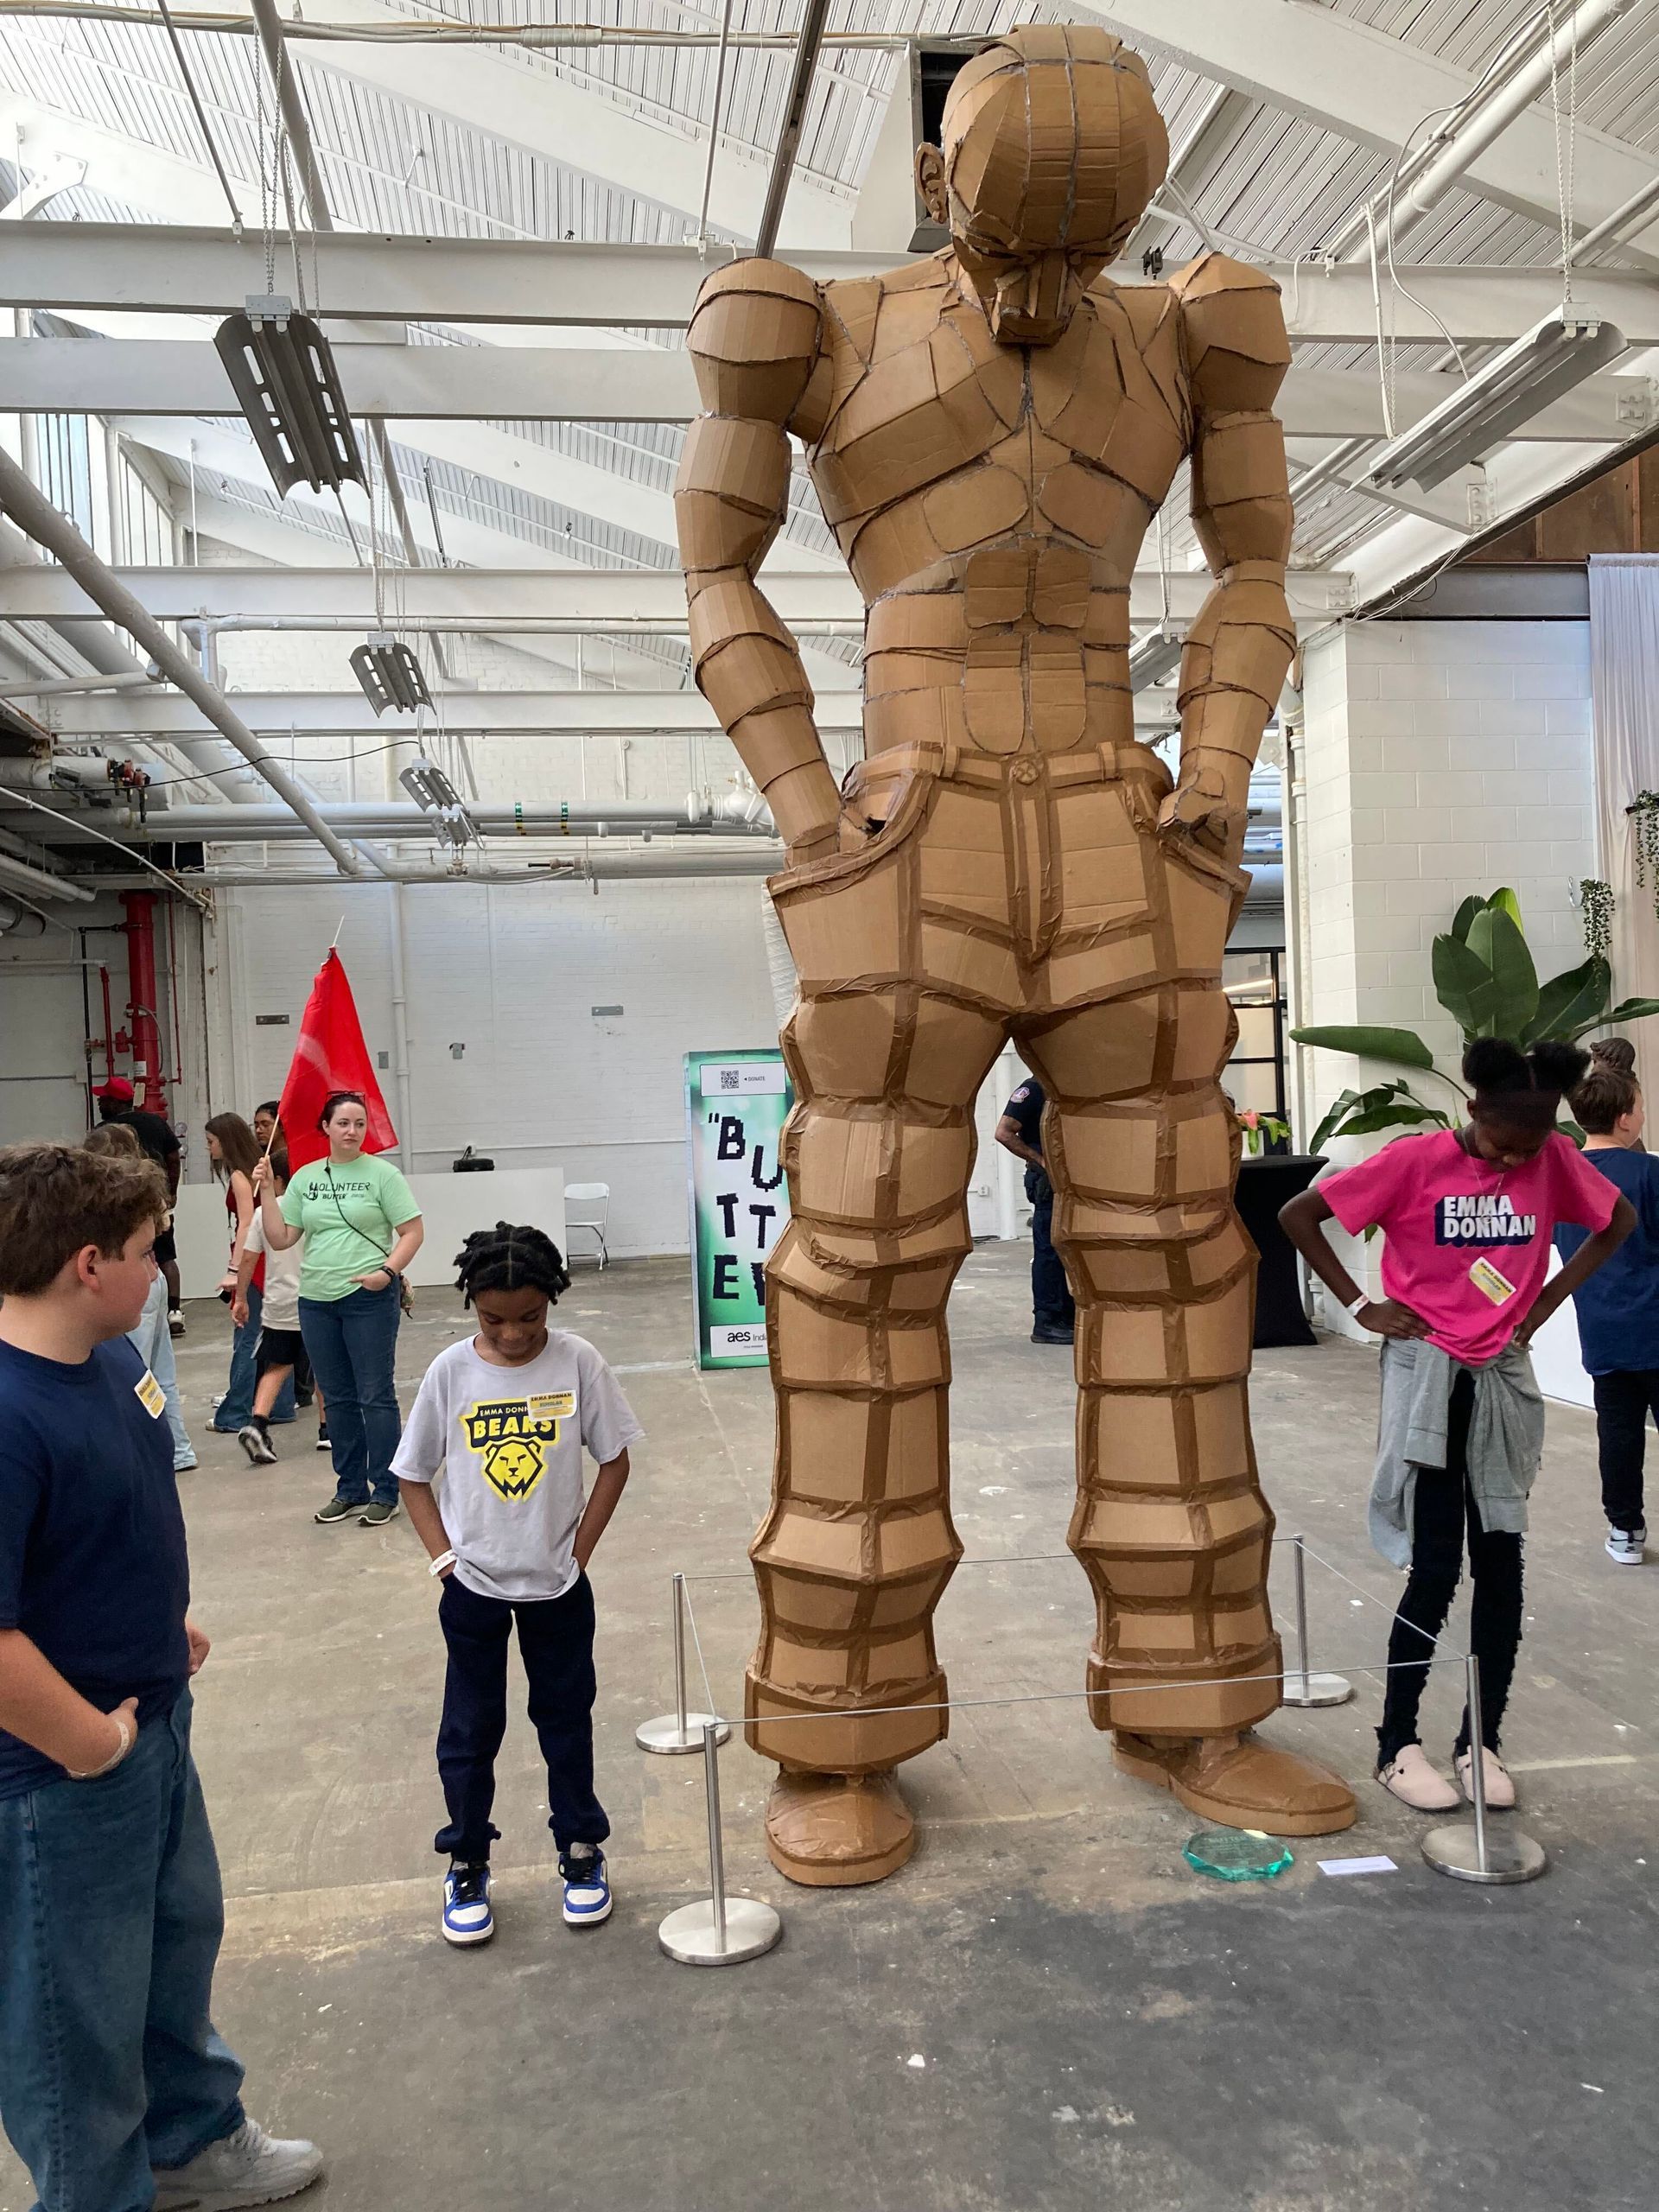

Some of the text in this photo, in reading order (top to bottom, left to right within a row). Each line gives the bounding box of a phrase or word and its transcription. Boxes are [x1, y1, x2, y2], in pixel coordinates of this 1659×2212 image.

[1444, 1195, 1515, 1217] EMMA
[1444, 1215, 1536, 1238] DONNAN
[728, 1332, 751, 1343] aes
[480, 1408, 503, 1417] EMMA
[474, 1415, 552, 1440] BEARS
